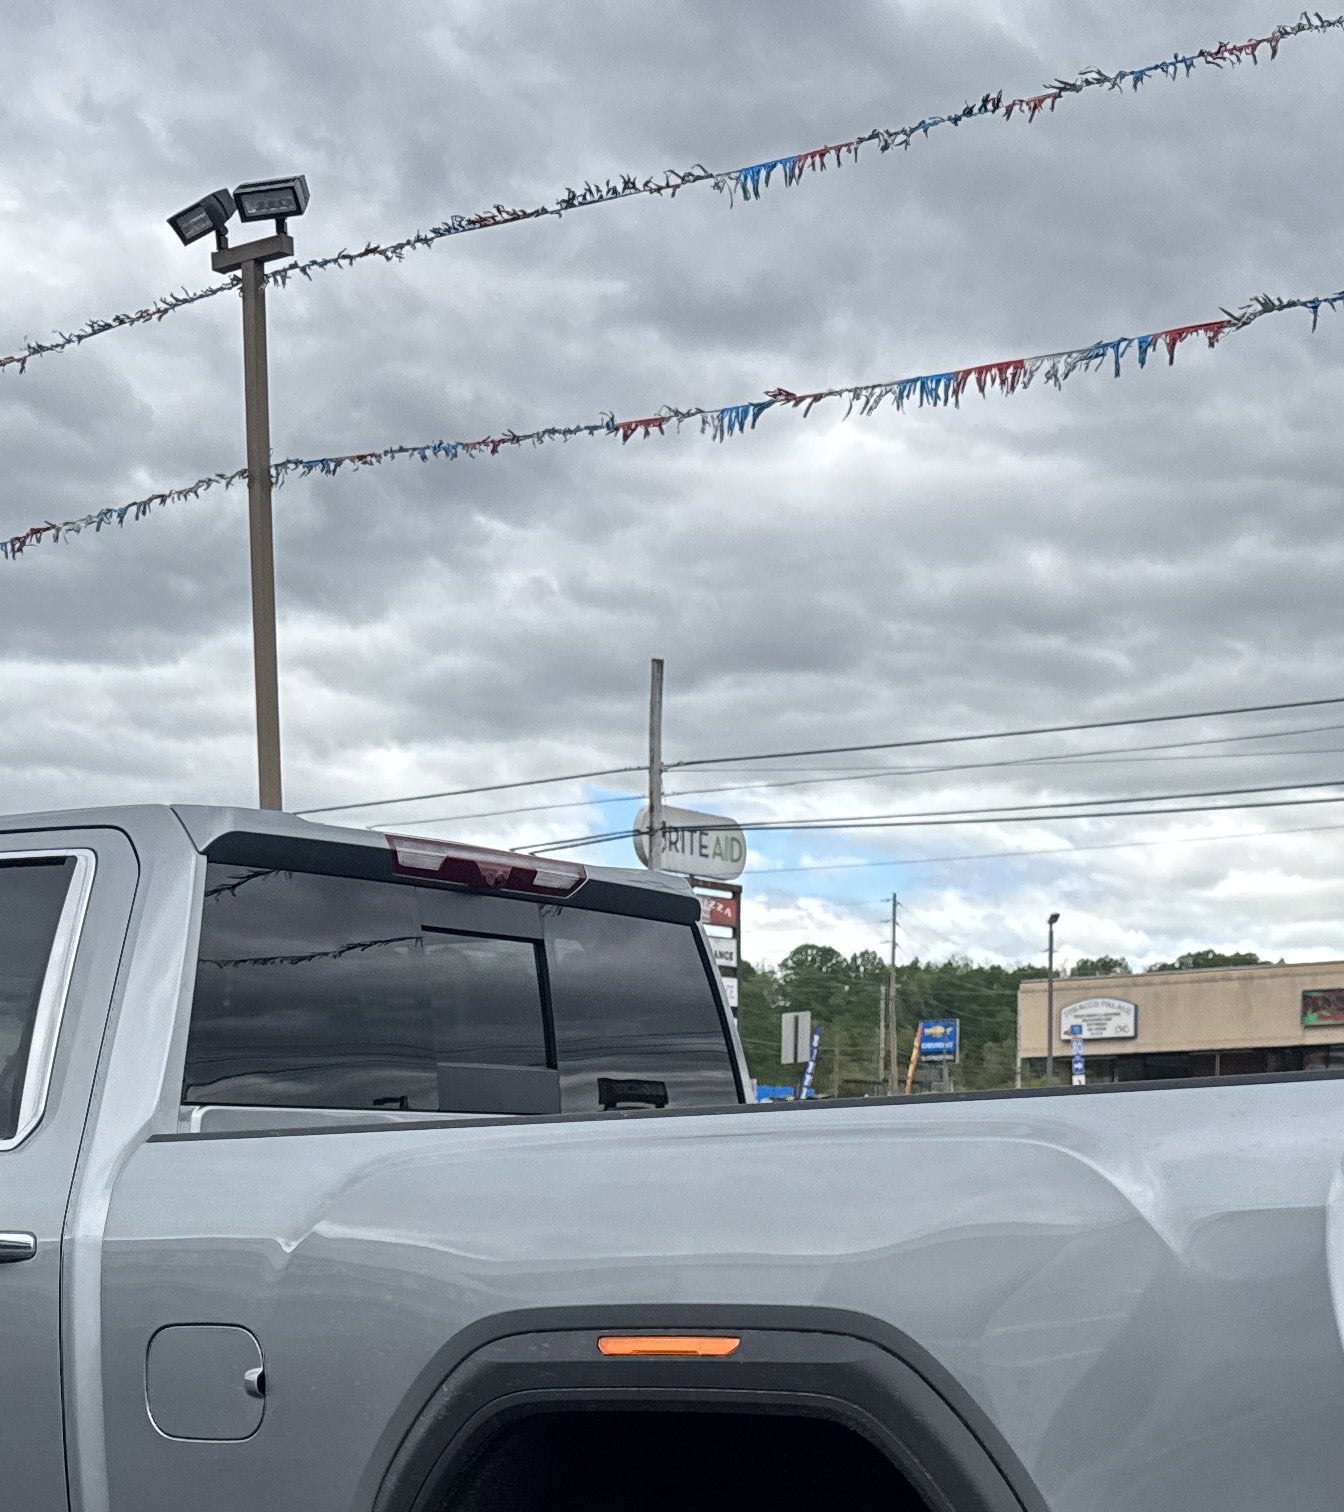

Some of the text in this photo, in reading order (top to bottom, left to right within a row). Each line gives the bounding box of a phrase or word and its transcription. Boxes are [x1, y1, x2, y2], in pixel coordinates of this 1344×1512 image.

[669, 824, 743, 863] RITE AID
[713, 948, 734, 962] ANCE
